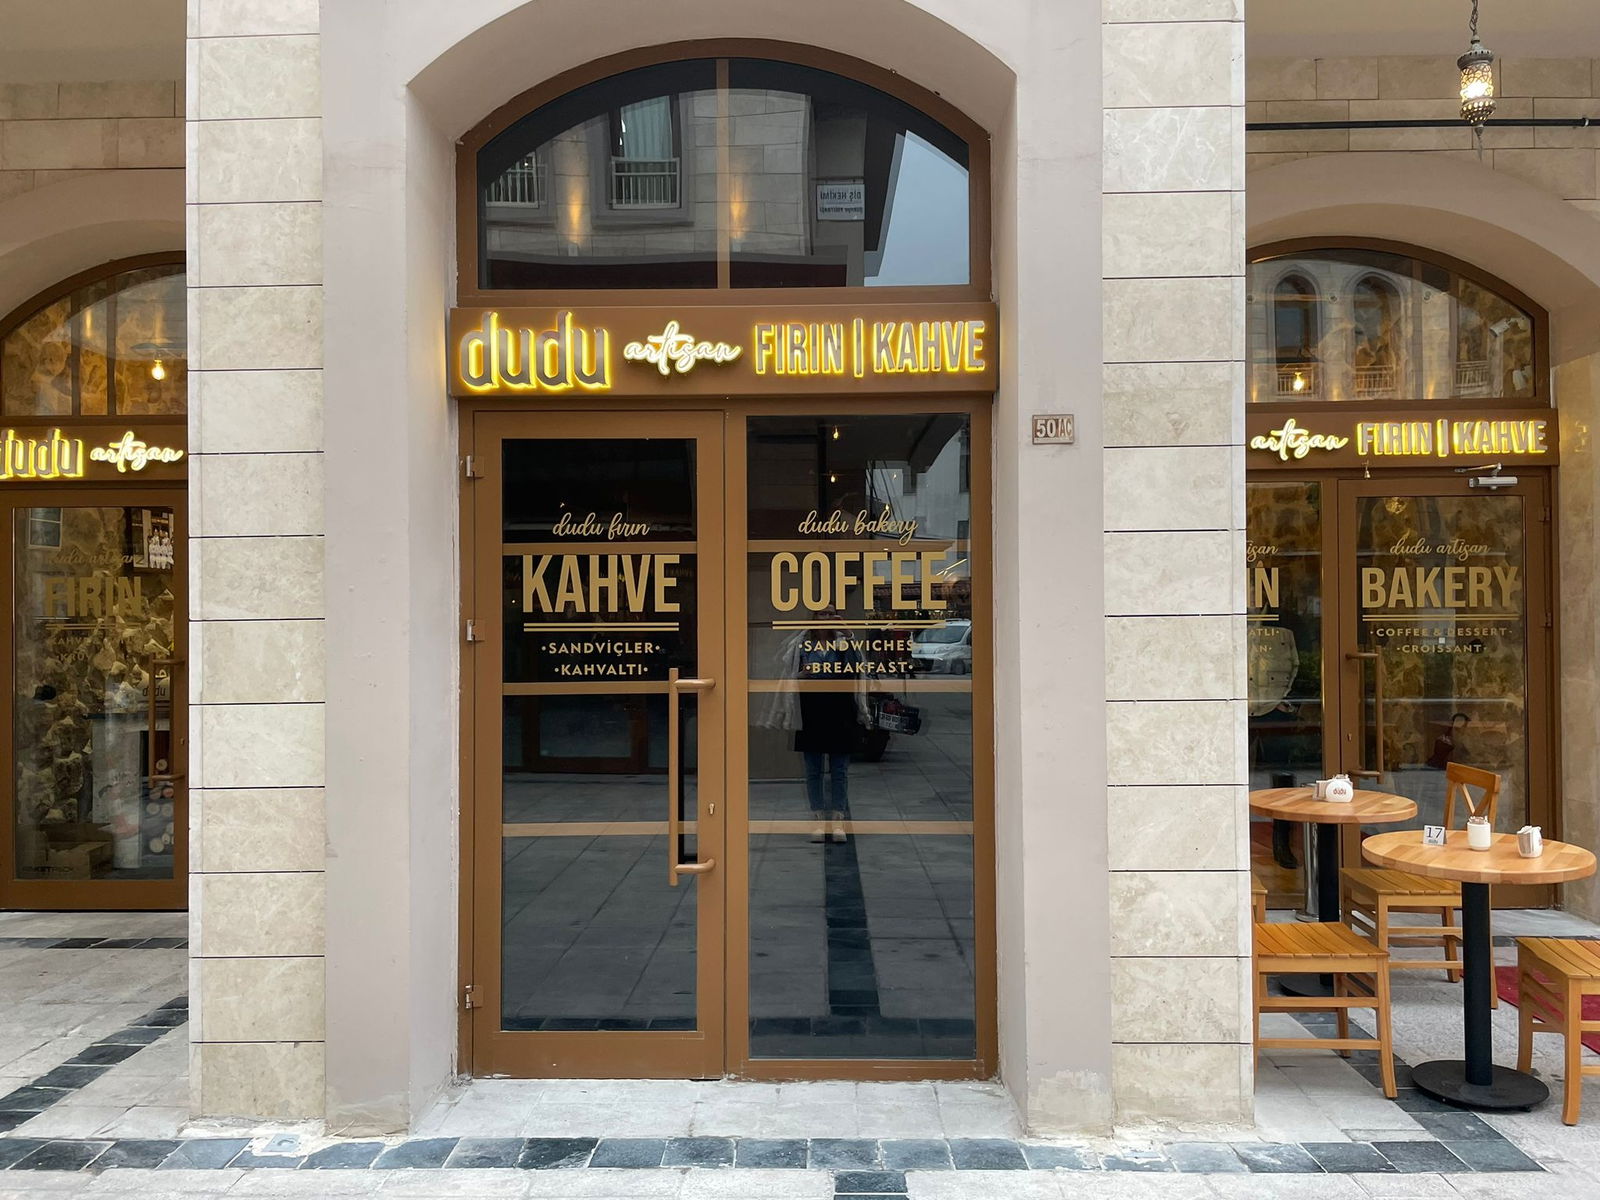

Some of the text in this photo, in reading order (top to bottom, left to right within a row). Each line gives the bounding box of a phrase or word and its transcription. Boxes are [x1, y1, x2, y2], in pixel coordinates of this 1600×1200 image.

[460, 310, 611, 389] dudu
[623, 320, 743, 376] artisan
[754, 322, 845, 375] FIRIN
[873, 319, 986, 374] KAHVE
[90, 430, 183, 473] artisan
[1250, 418, 1349, 461] artisan
[1357, 421, 1432, 455] FIRIN
[1453, 419, 1547, 455] KAHVE
[552, 512, 603, 536] dudu
[798, 509, 918, 547] dudu bakery
[1390, 536, 1489, 560] dudu artisan
[45, 576, 142, 617] FIRIN
[522, 554, 680, 613] KAHVE
[771, 551, 947, 611] COFFEE
[1361, 566, 1518, 609] BAKERY
[1426, 826, 1443, 839] 17
